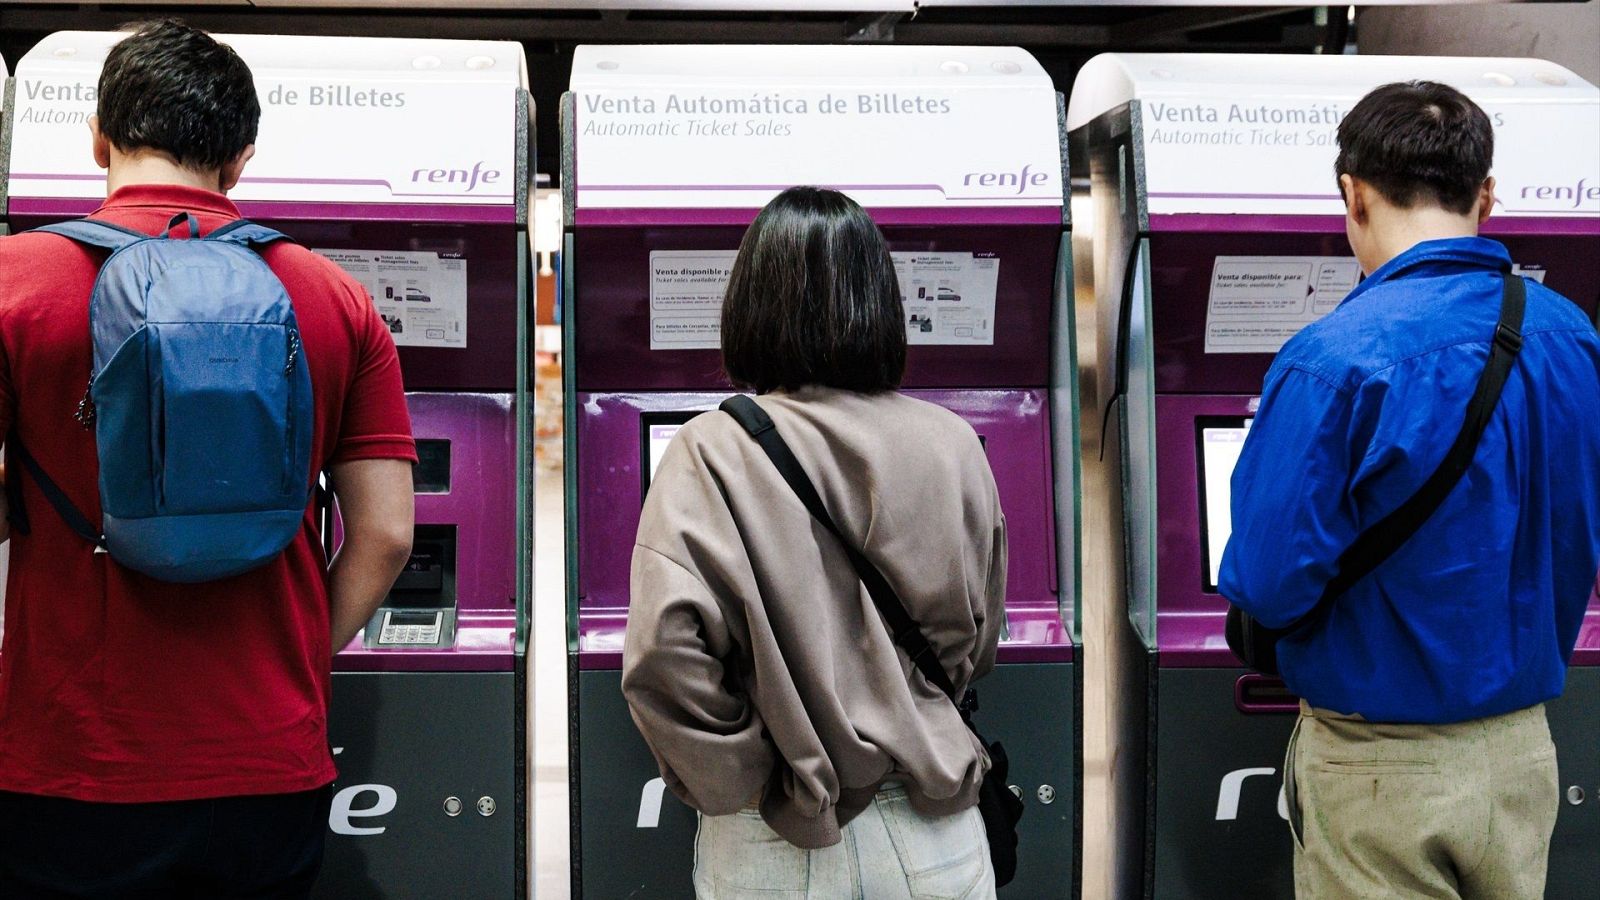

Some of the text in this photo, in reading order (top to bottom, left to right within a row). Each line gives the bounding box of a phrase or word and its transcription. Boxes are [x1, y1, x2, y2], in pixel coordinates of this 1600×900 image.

[24, 80, 406, 108] Venta de Billetes
[585, 93, 951, 114] Venta Automática de Billetes
[1150, 103, 1218, 123] Venta
[584, 119, 792, 137] Automatic Ticket Sales
[1150, 128, 1242, 145] Automatic
[1250, 129, 1299, 146] Ticket
[411, 161, 500, 192] renfe
[963, 164, 1048, 194] renfe
[1521, 178, 1600, 209] renfe
[680, 268, 722, 276] disponible
[1217, 273, 1239, 281] Venta
[1241, 273, 1281, 282] disponible
